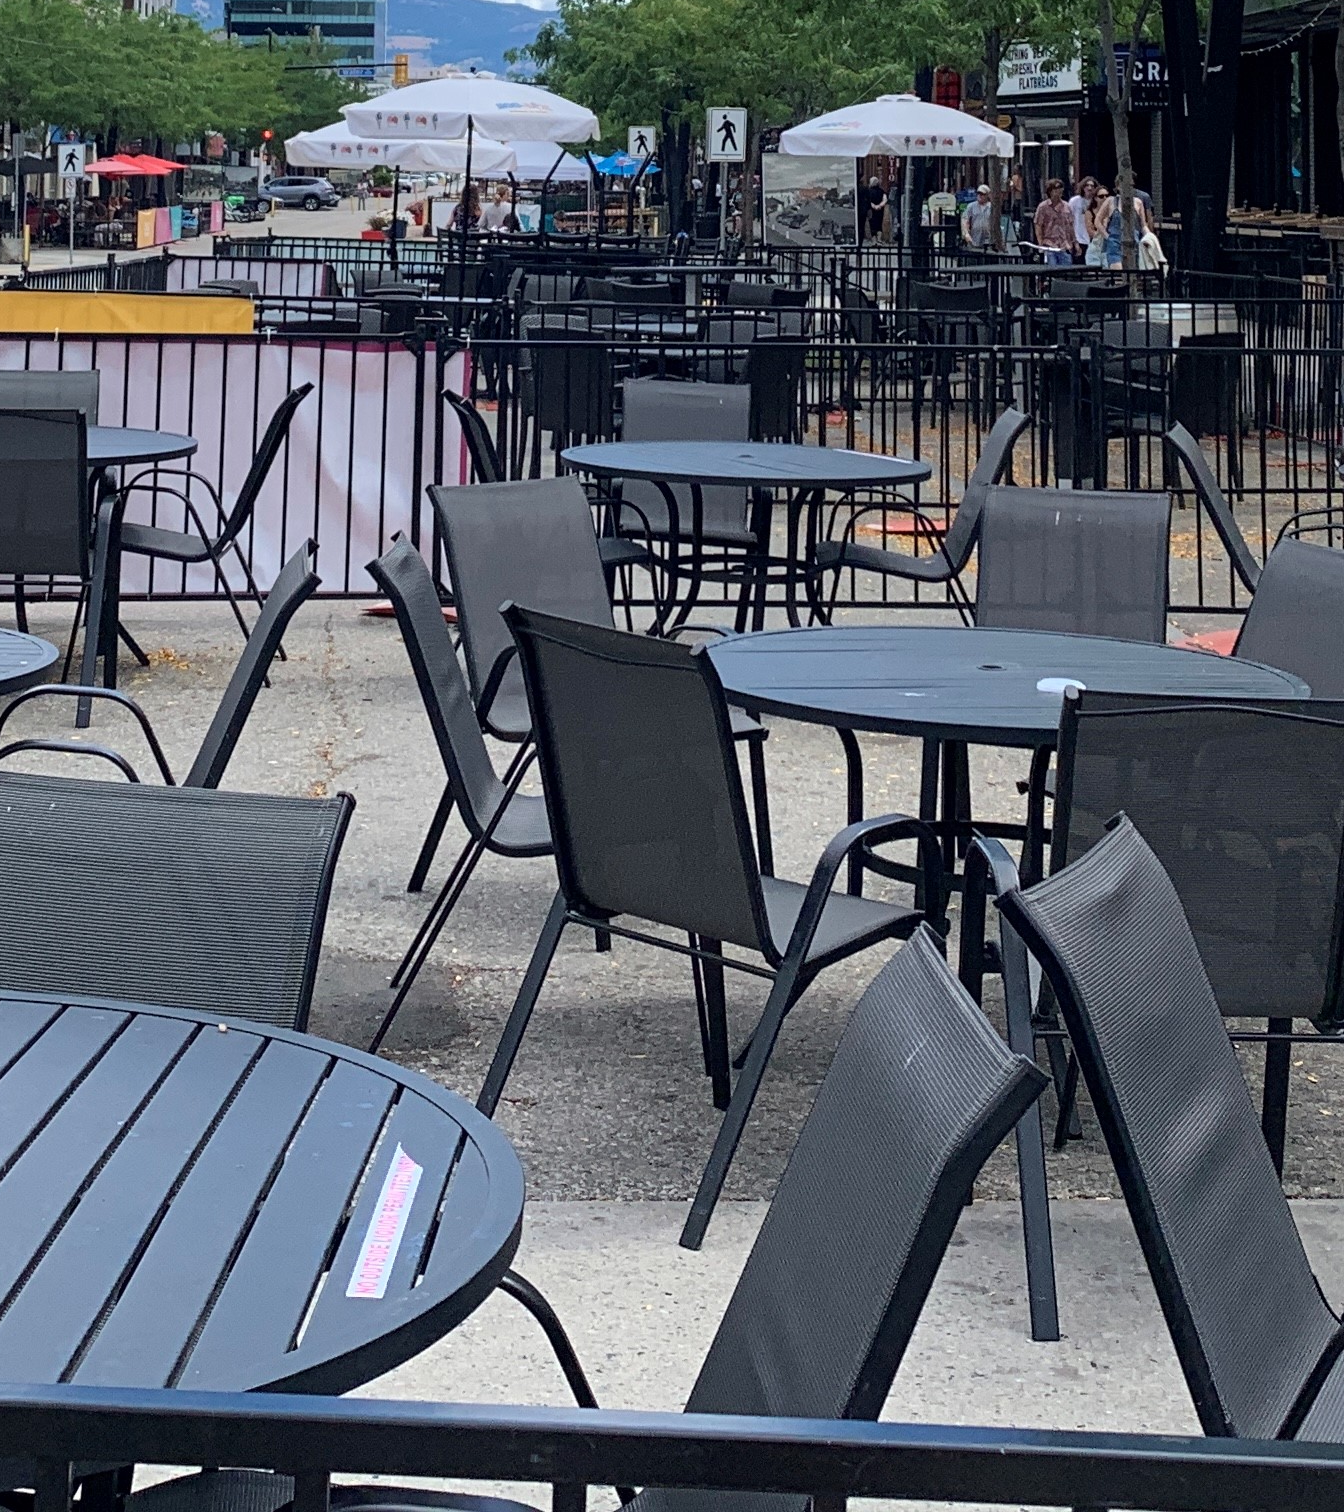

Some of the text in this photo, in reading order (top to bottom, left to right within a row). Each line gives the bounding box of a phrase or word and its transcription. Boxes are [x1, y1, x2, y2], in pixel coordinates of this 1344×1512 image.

[372, 1214, 400, 1243] LIQUOR
[359, 1244, 391, 1280] OUTSIDE
[355, 1281, 378, 1294] NO
